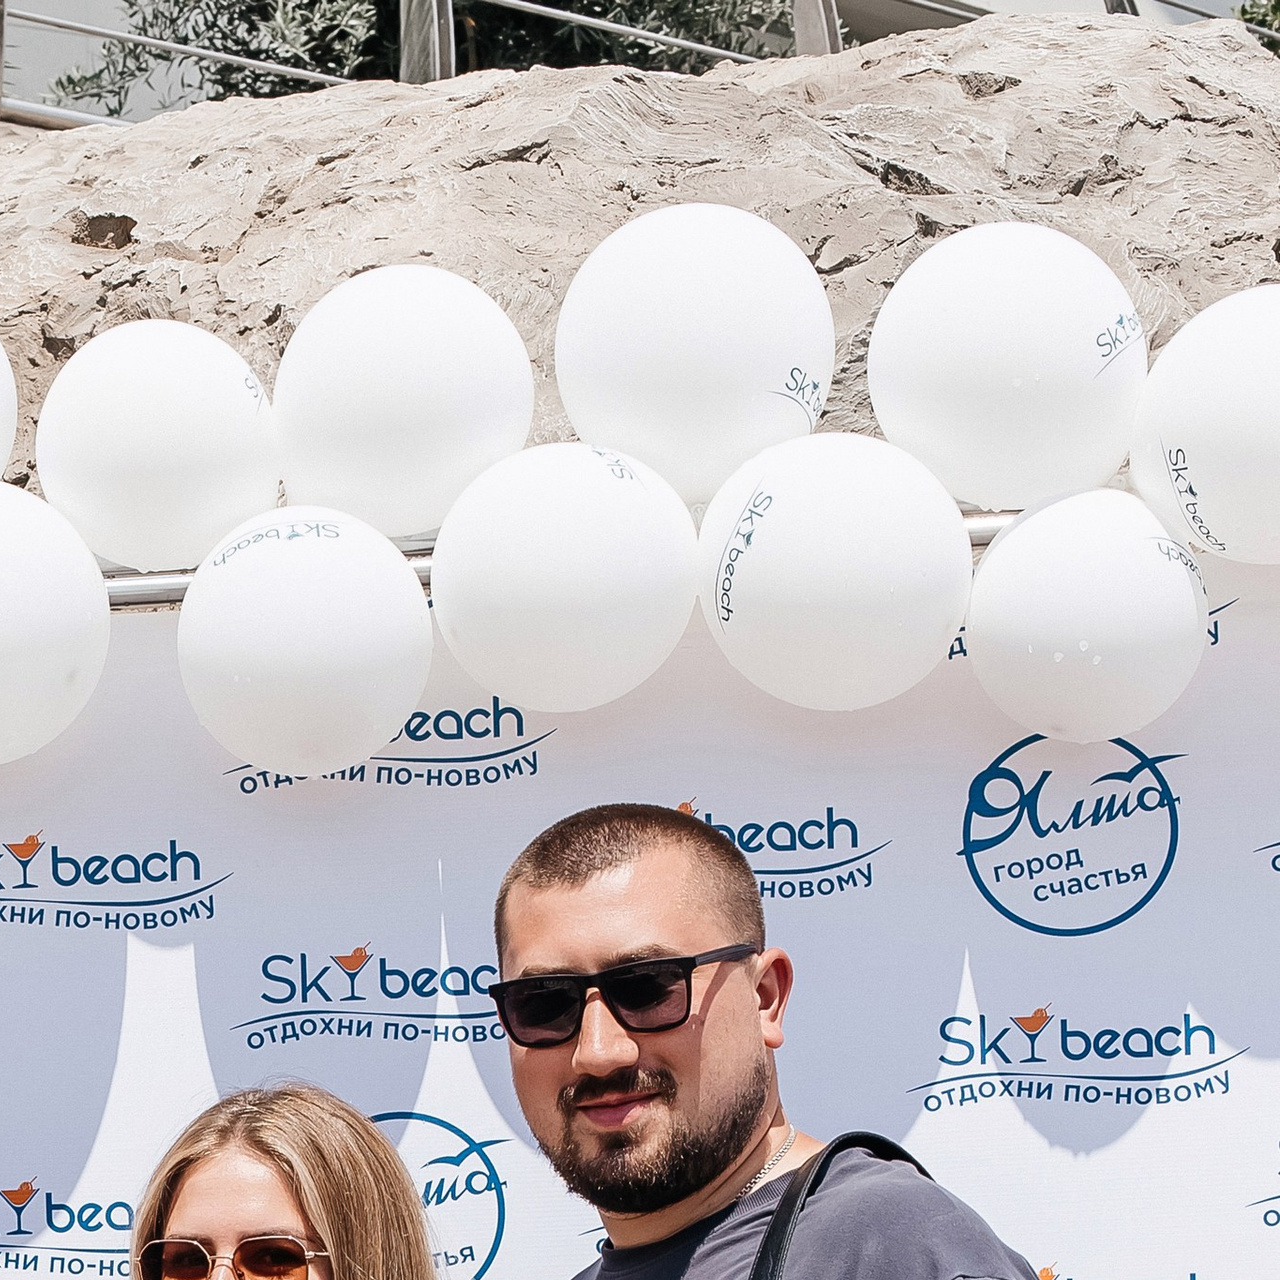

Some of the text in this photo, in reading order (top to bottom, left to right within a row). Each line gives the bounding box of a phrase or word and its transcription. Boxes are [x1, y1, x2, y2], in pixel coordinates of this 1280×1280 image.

[720, 547, 745, 622] beach
[389, 696, 524, 743] each
[51, 839, 201, 887] beach
[993, 848, 1084, 883] город
[1032, 859, 1148, 903] счастья
[378, 956, 500, 1000] beac
[382, 1020, 507, 1043] по-ново
[1060, 1013, 1216, 1061] beach
[45, 1191, 135, 1234] bea
